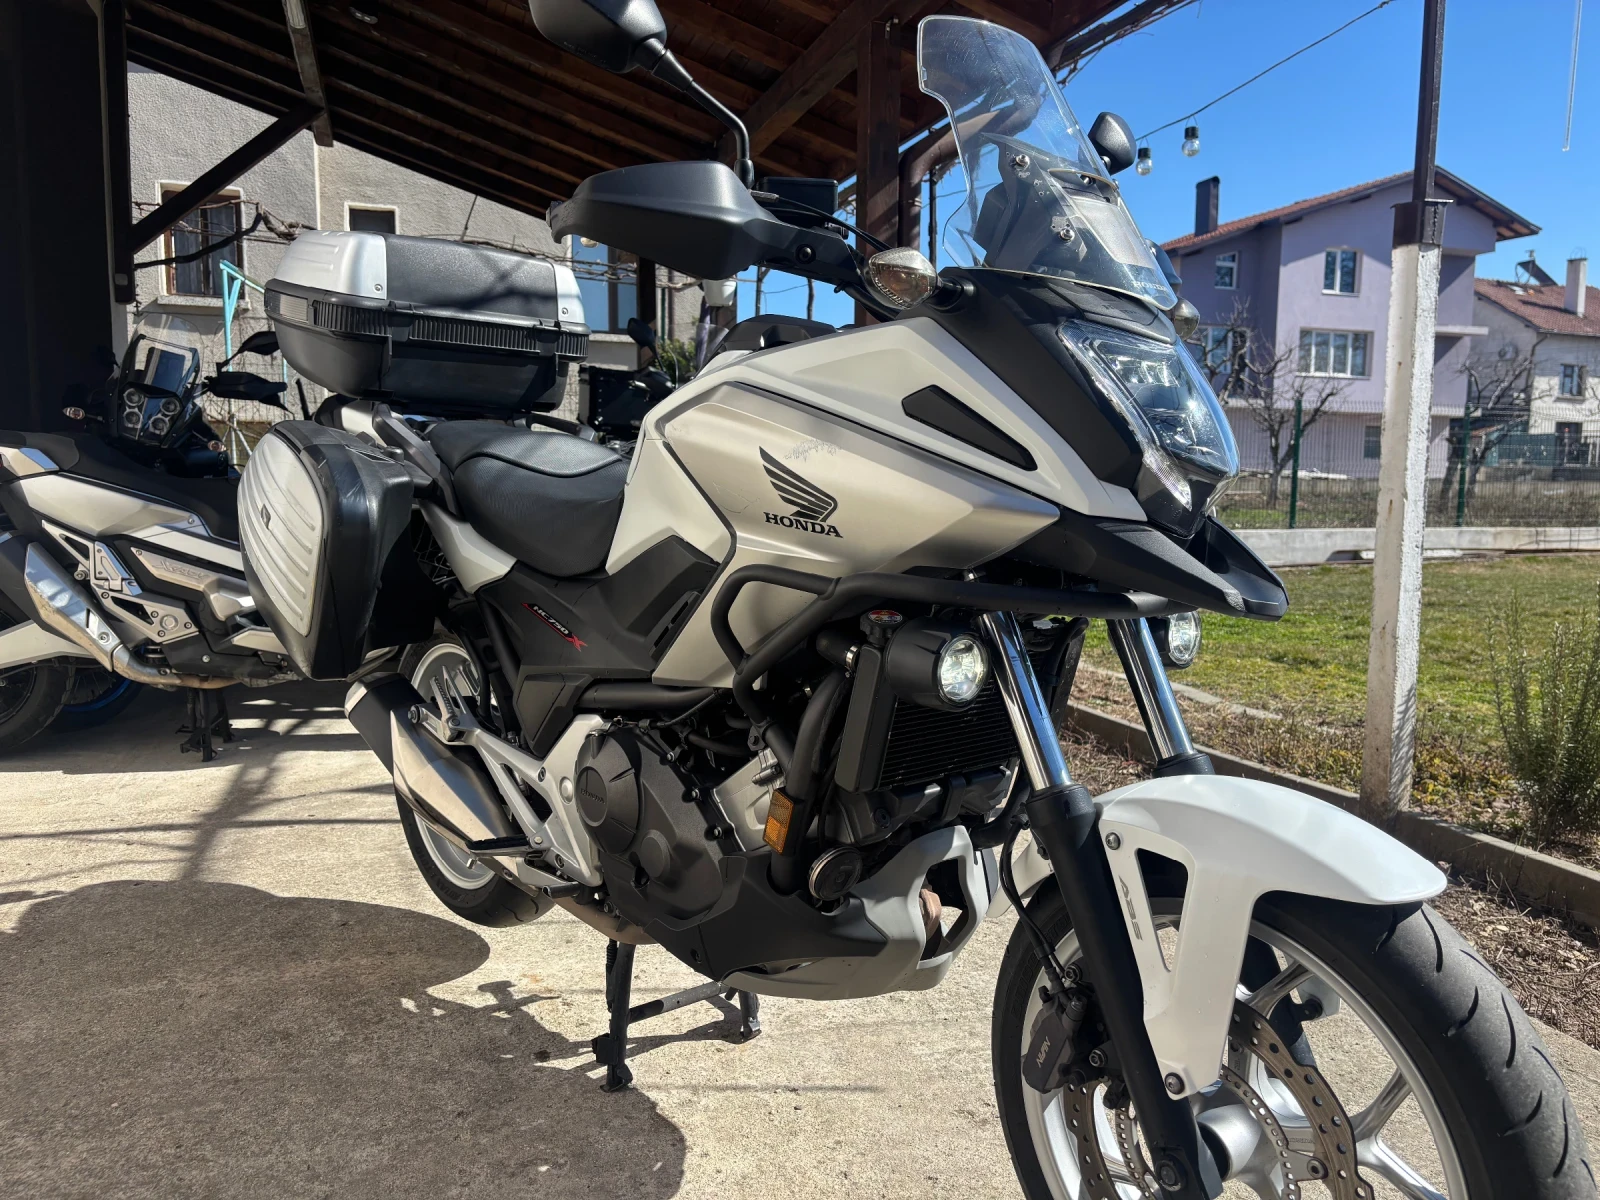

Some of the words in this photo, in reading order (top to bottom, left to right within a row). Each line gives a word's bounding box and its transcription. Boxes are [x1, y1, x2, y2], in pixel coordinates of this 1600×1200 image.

[763, 511, 844, 539] HONDA
[580, 787, 606, 805] HONDA
[1118, 875, 1143, 941] ABS
